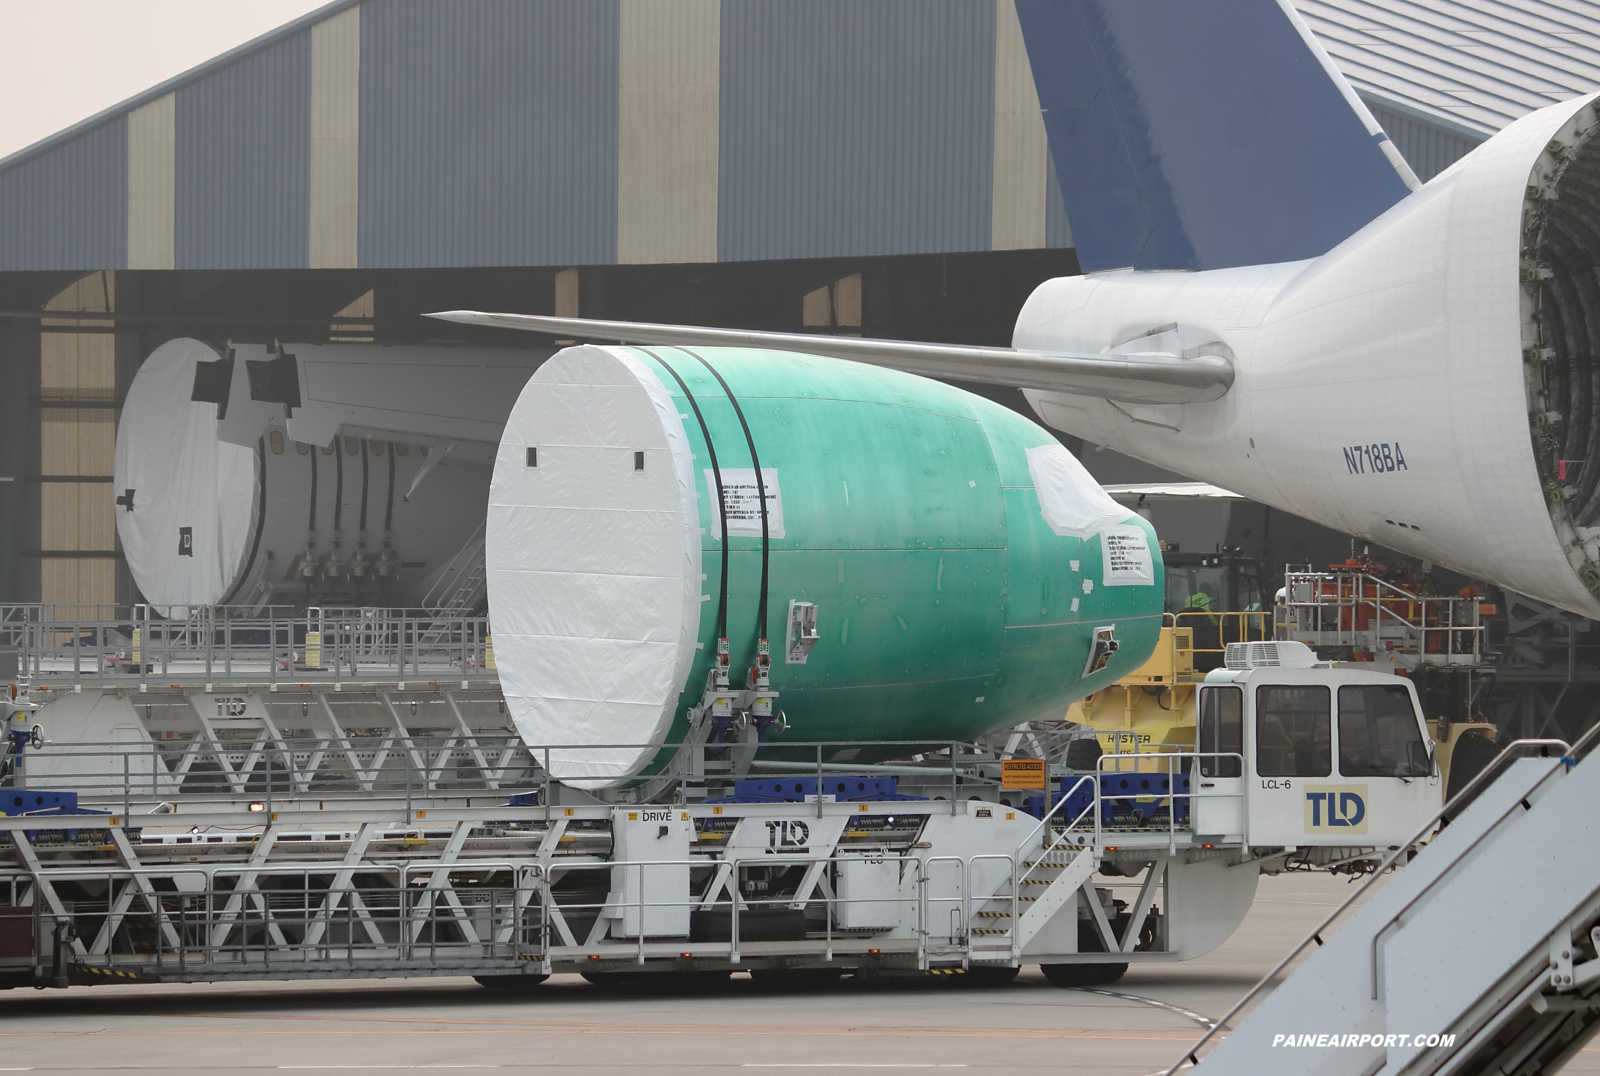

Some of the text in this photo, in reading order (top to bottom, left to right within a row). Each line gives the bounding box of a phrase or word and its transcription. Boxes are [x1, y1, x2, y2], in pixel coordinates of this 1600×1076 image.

[1343, 442, 1408, 474] N718BA
[214, 697, 246, 716] TLD
[1262, 779, 1291, 789] LCL-6
[643, 812, 672, 822] DRIVE
[1307, 792, 1365, 827] TLD
[765, 821, 809, 847] TLD
